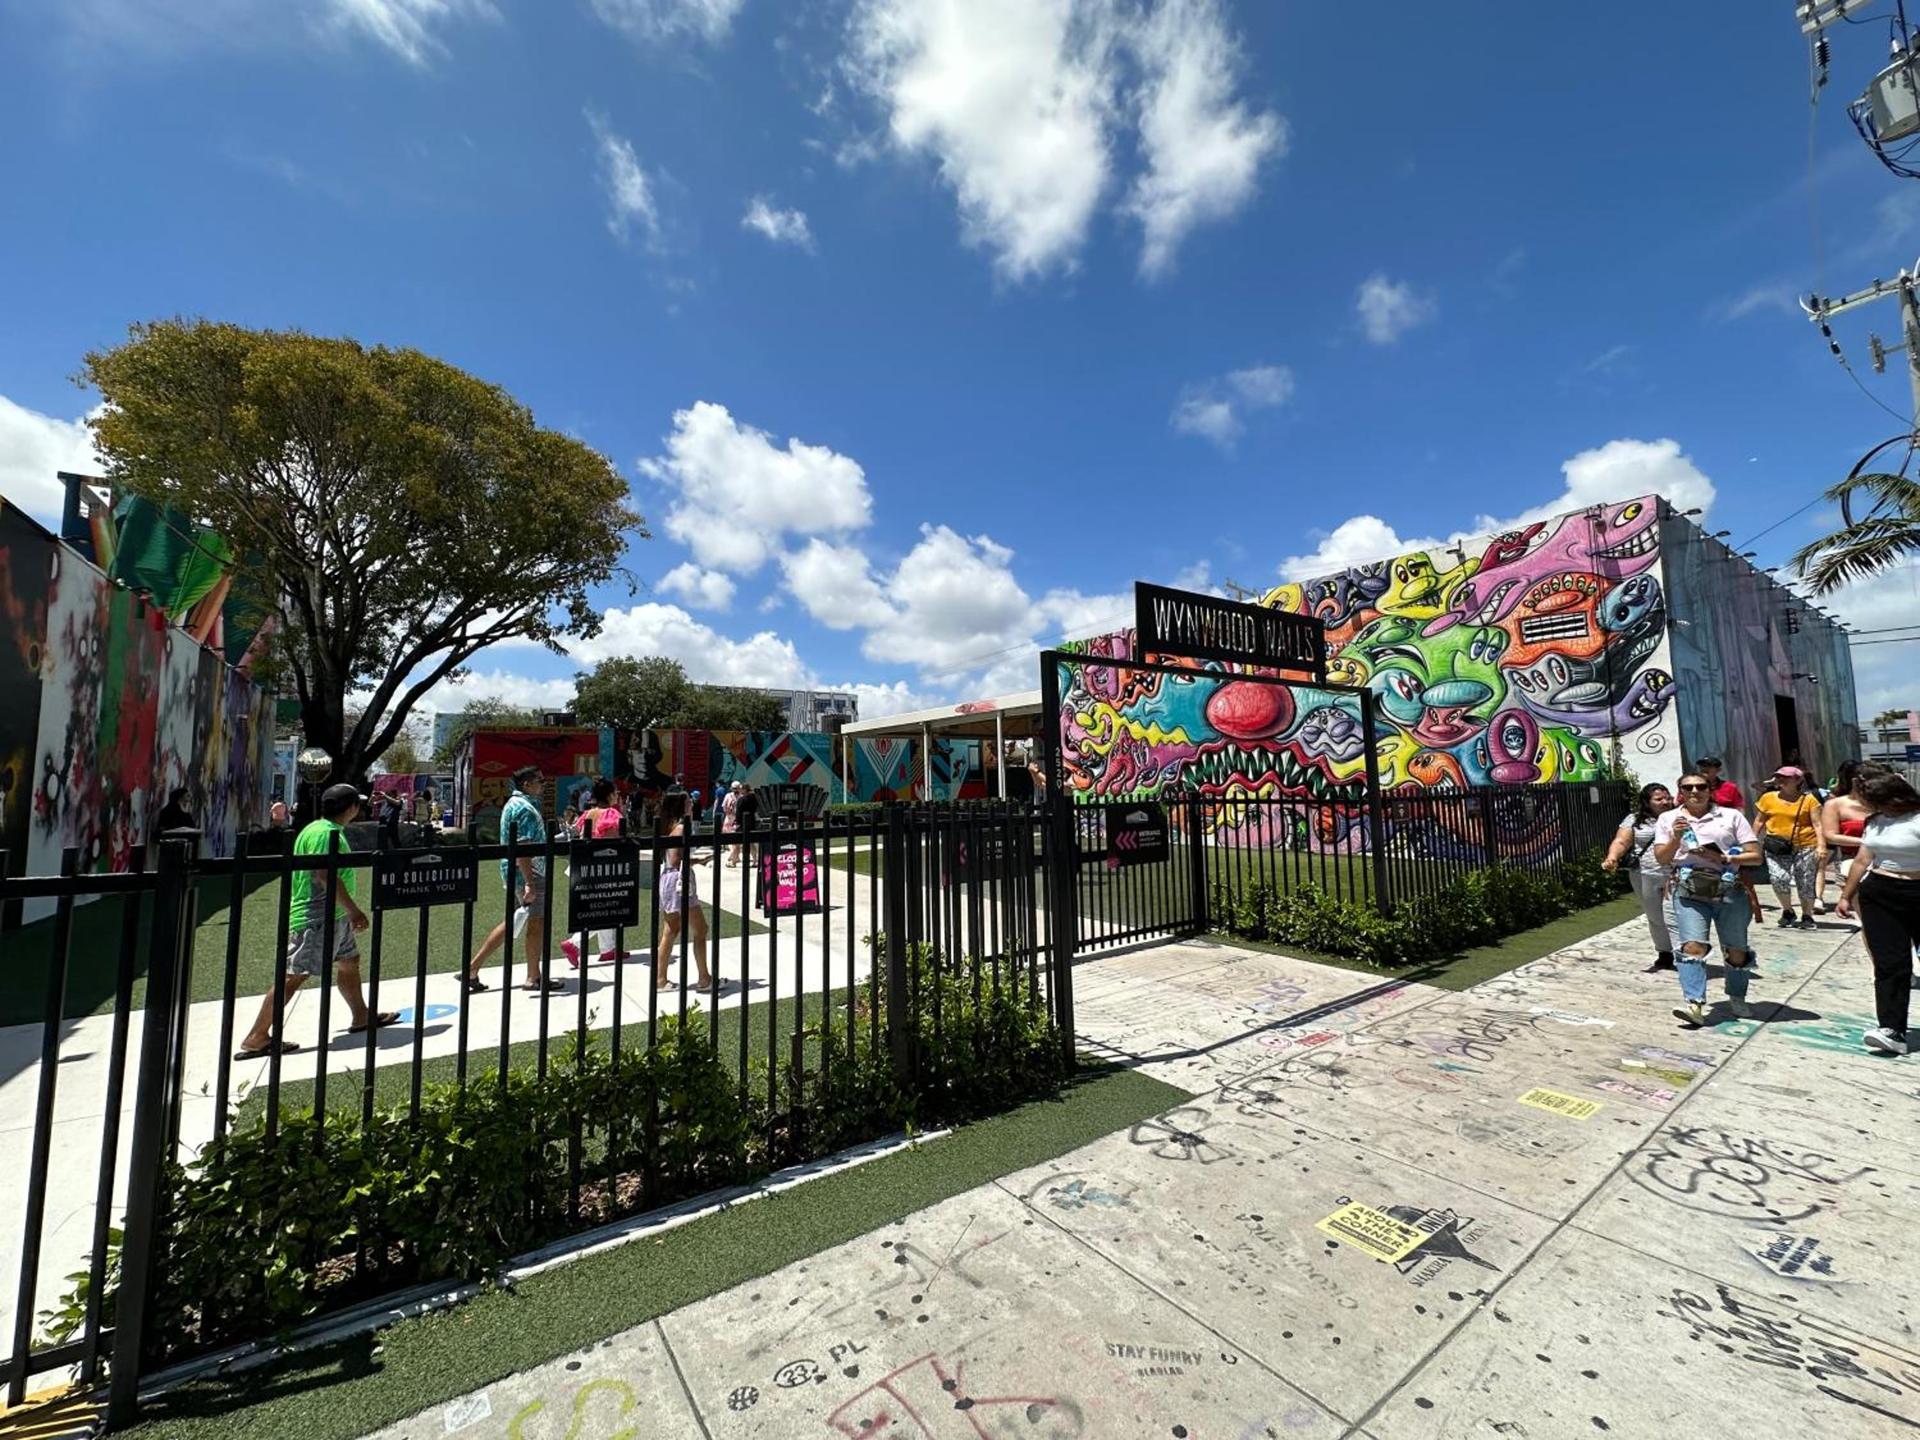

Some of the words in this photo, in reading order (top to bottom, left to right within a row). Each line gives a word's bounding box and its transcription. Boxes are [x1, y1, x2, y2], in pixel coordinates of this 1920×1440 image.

[1152, 597, 1256, 653] WYNWOOD
[1263, 618, 1315, 662] WALLS
[381, 872, 395, 886] NO
[403, 867, 470, 884] SOLICITING
[580, 862, 630, 878] WARNING
[395, 886, 430, 895] THANK
[435, 883, 456, 892] YOU
[580, 890, 629, 900] SURVEILLANCE
[1353, 1206, 1420, 1238] AROUND
[1364, 1218, 1395, 1235] THE
[1340, 1216, 1404, 1249] CORNER
[1105, 1343, 1146, 1359] STAY
[1149, 1346, 1203, 1366] FUNKY
